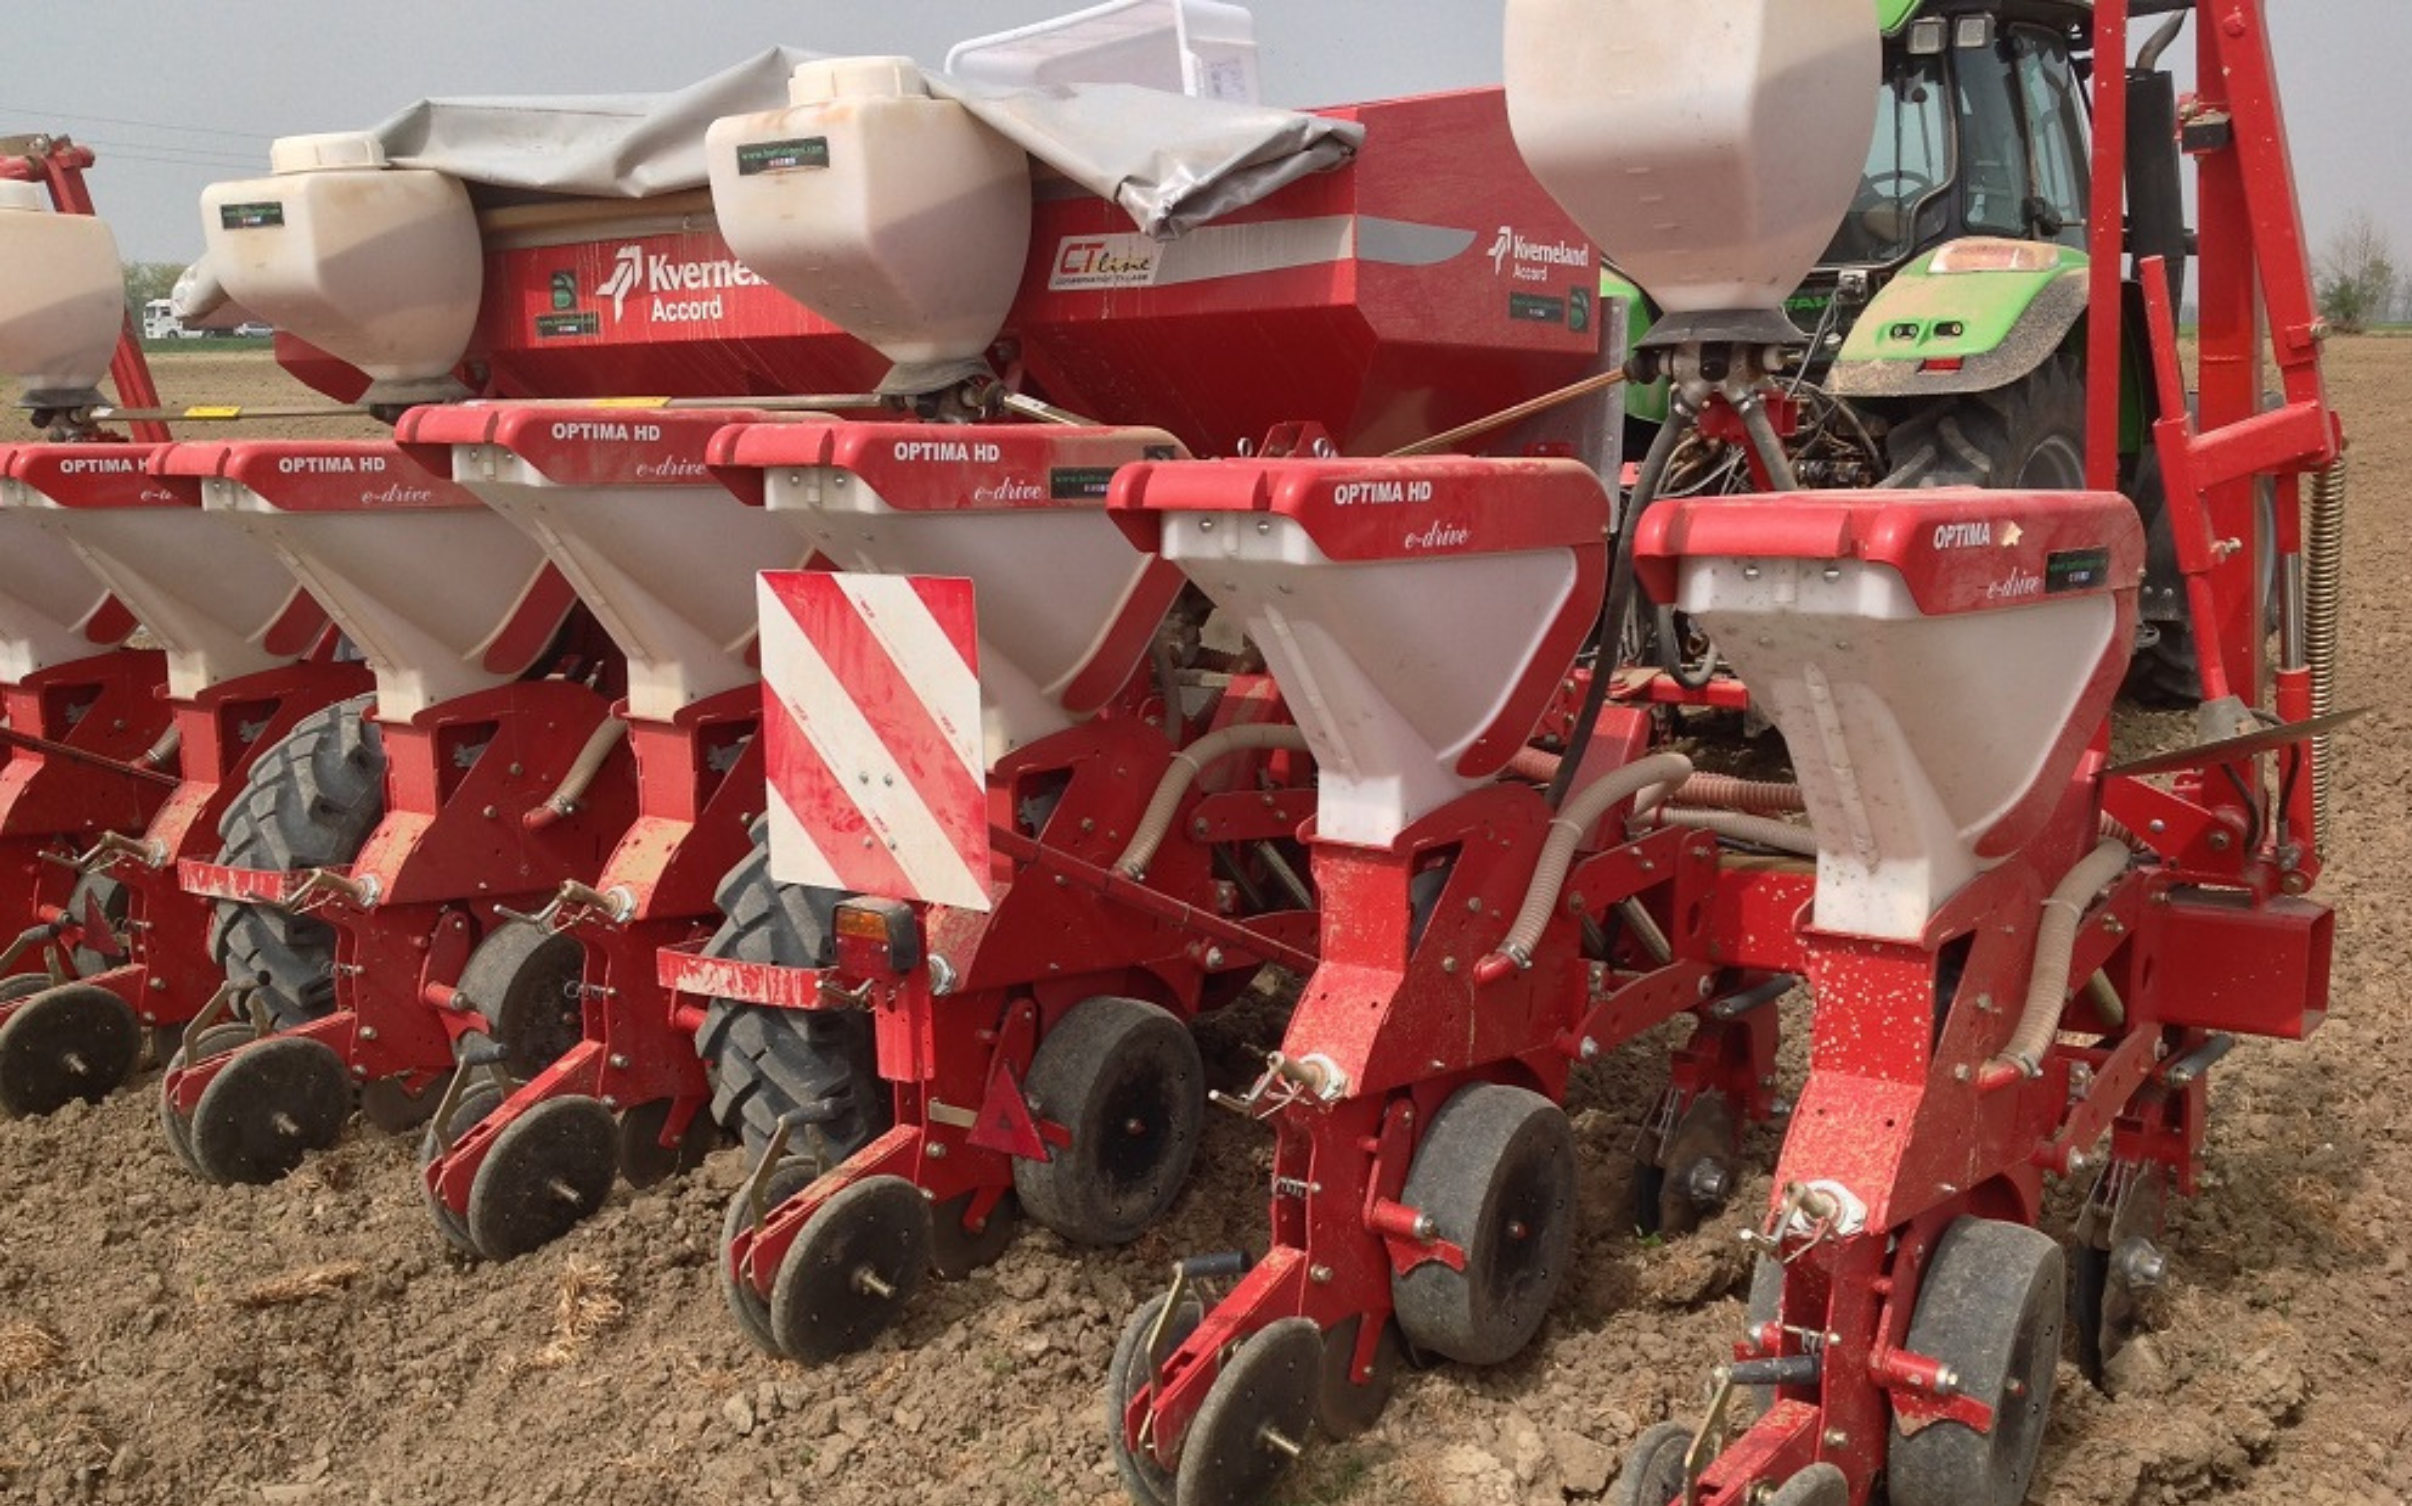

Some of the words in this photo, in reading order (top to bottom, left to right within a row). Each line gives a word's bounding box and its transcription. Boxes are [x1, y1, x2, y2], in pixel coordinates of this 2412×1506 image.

[1514, 235, 1589, 267] Kverneland
[650, 254, 769, 292] Kverne
[651, 295, 722, 322] Accord
[553, 422, 628, 440] OPTIMA
[634, 425, 661, 441] HD
[894, 442, 968, 461] OPTIMA
[974, 445, 1000, 462] HD
[60, 459, 133, 473] OPTIMA
[279, 457, 355, 472] OPTIMA
[359, 457, 386, 471] HD
[636, 454, 706, 477] e-drive
[361, 483, 431, 504] e-drive
[974, 477, 1042, 501] e-drive
[1334, 481, 1403, 505] OPTIMA
[1408, 481, 1432, 501] HD
[1405, 519, 1470, 549] e-drive
[1933, 523, 1990, 550] OPTIMA
